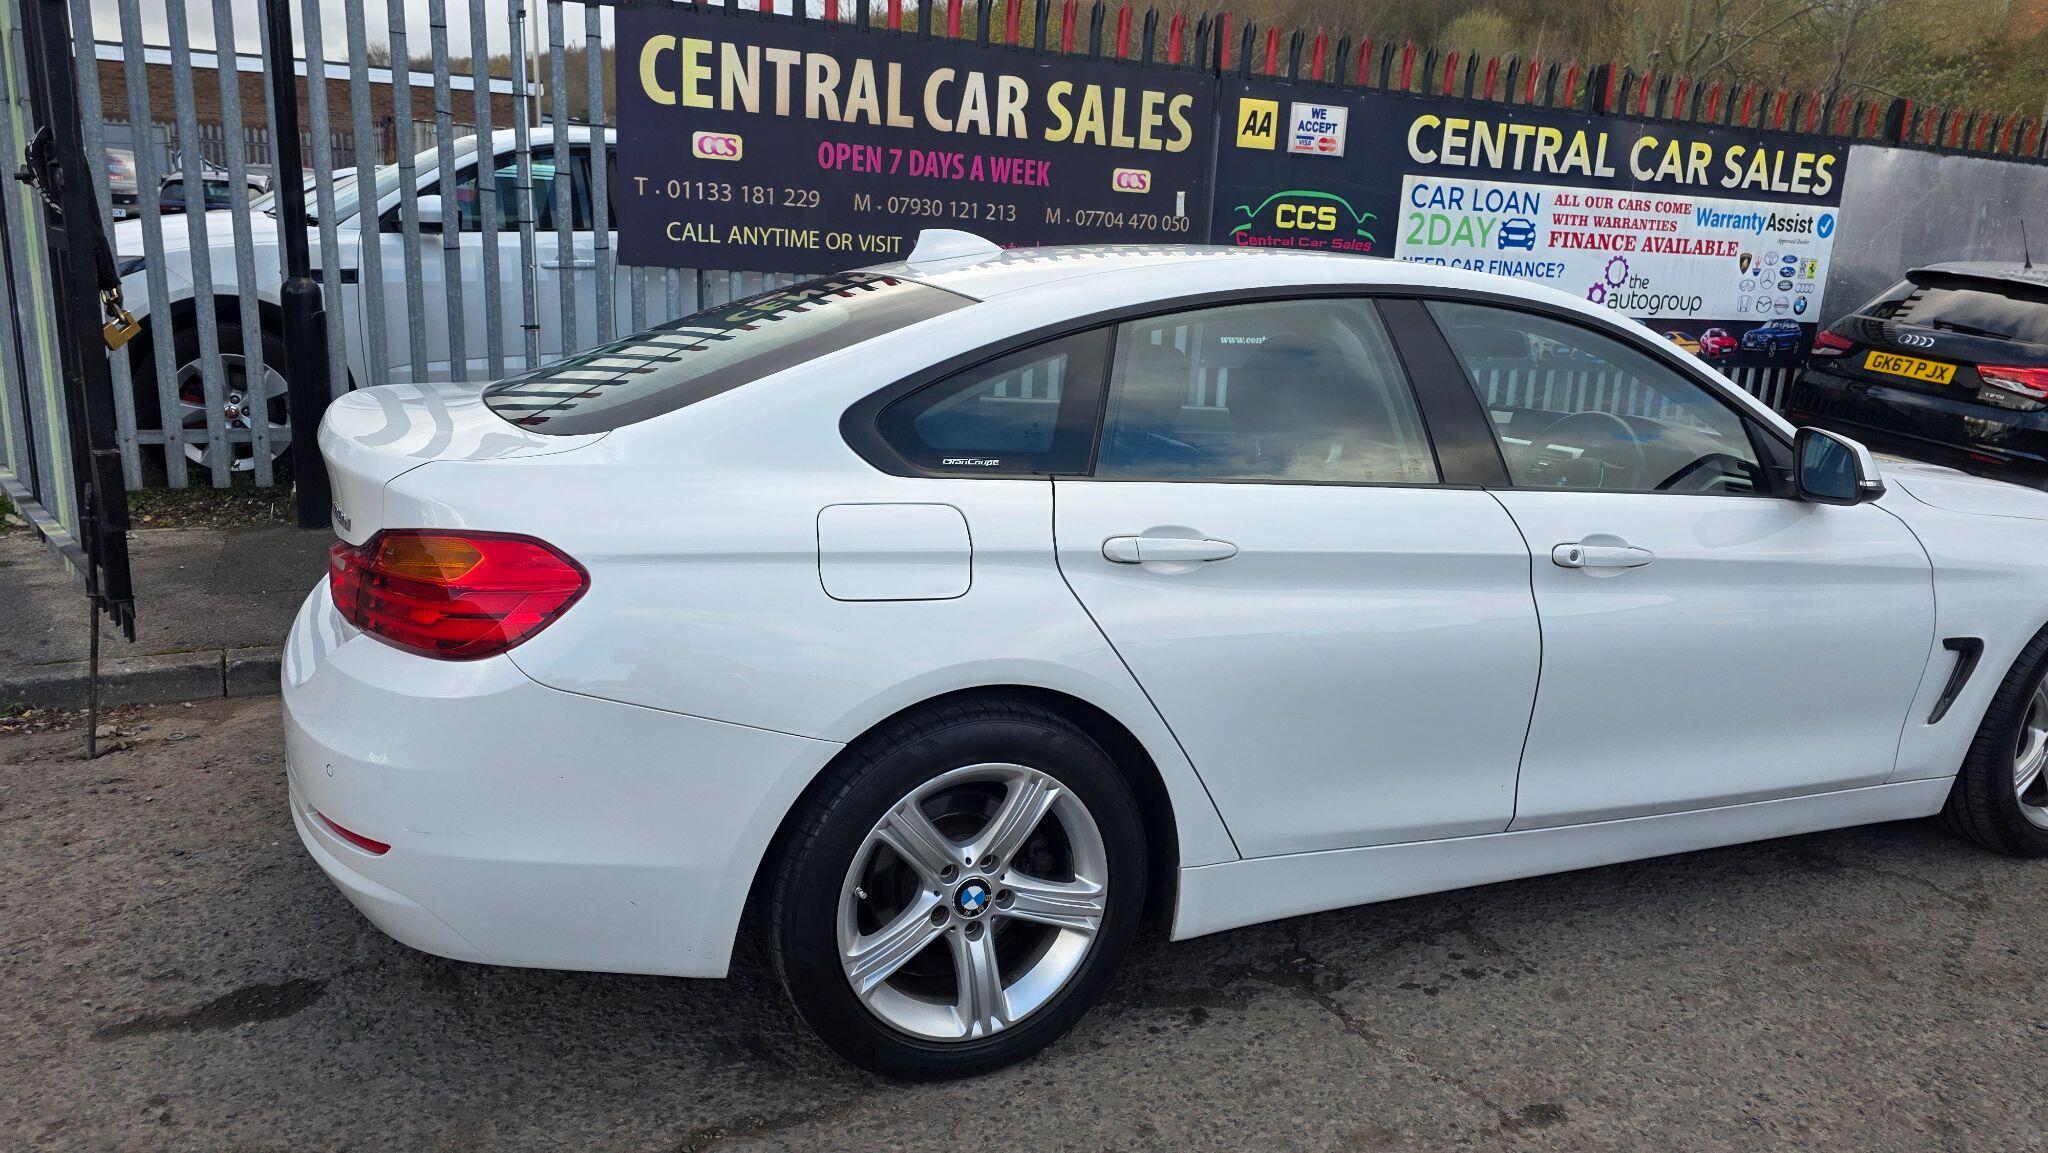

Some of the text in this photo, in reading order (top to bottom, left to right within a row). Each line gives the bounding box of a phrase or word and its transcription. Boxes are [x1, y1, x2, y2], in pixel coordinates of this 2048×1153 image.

[640, 34, 1193, 153] CENTRAL CAR SALES
[1242, 110, 1272, 137] AA
[1298, 120, 1338, 134] ACCEPT
[1312, 108, 1328, 120] WE
[697, 134, 738, 157] CCS
[1407, 114, 1837, 196] CENTRAL CAR SALES
[818, 141, 1051, 187] OPEN 7 DAYS A WEEK
[1116, 171, 1147, 190] CCS
[667, 179, 732, 202] 01133
[742, 185, 774, 205] 181
[784, 189, 820, 209] 229
[1411, 184, 1541, 215] CAR LOAN
[1554, 194, 1692, 215] ALL OUR CARS COME
[888, 195, 943, 217] 07930
[950, 202, 977, 219] 121
[986, 204, 1016, 222] 213
[1075, 209, 1124, 229] 07704
[1128, 213, 1157, 230] 470
[1162, 215, 1190, 232] 050
[1276, 204, 1337, 231] CCS
[1406, 212, 1498, 248] 2DAY
[1552, 213, 1678, 232] WITH WARRANTIES
[666, 221, 721, 244] CALL
[728, 225, 820, 249] ANYTIME
[826, 232, 852, 251] OR
[859, 234, 903, 254] VISIT
[1235, 231, 1372, 252] Central Car Sales
[1548, 231, 1739, 257] FINANCE AVAILABLE
[1451, 258, 1484, 273] CAR
[1488, 260, 1565, 278] FINANCE?
[1629, 273, 1650, 289] the
[1606, 291, 1702, 316] autogroup
[1872, 354, 1950, 381] GK67 PJX
